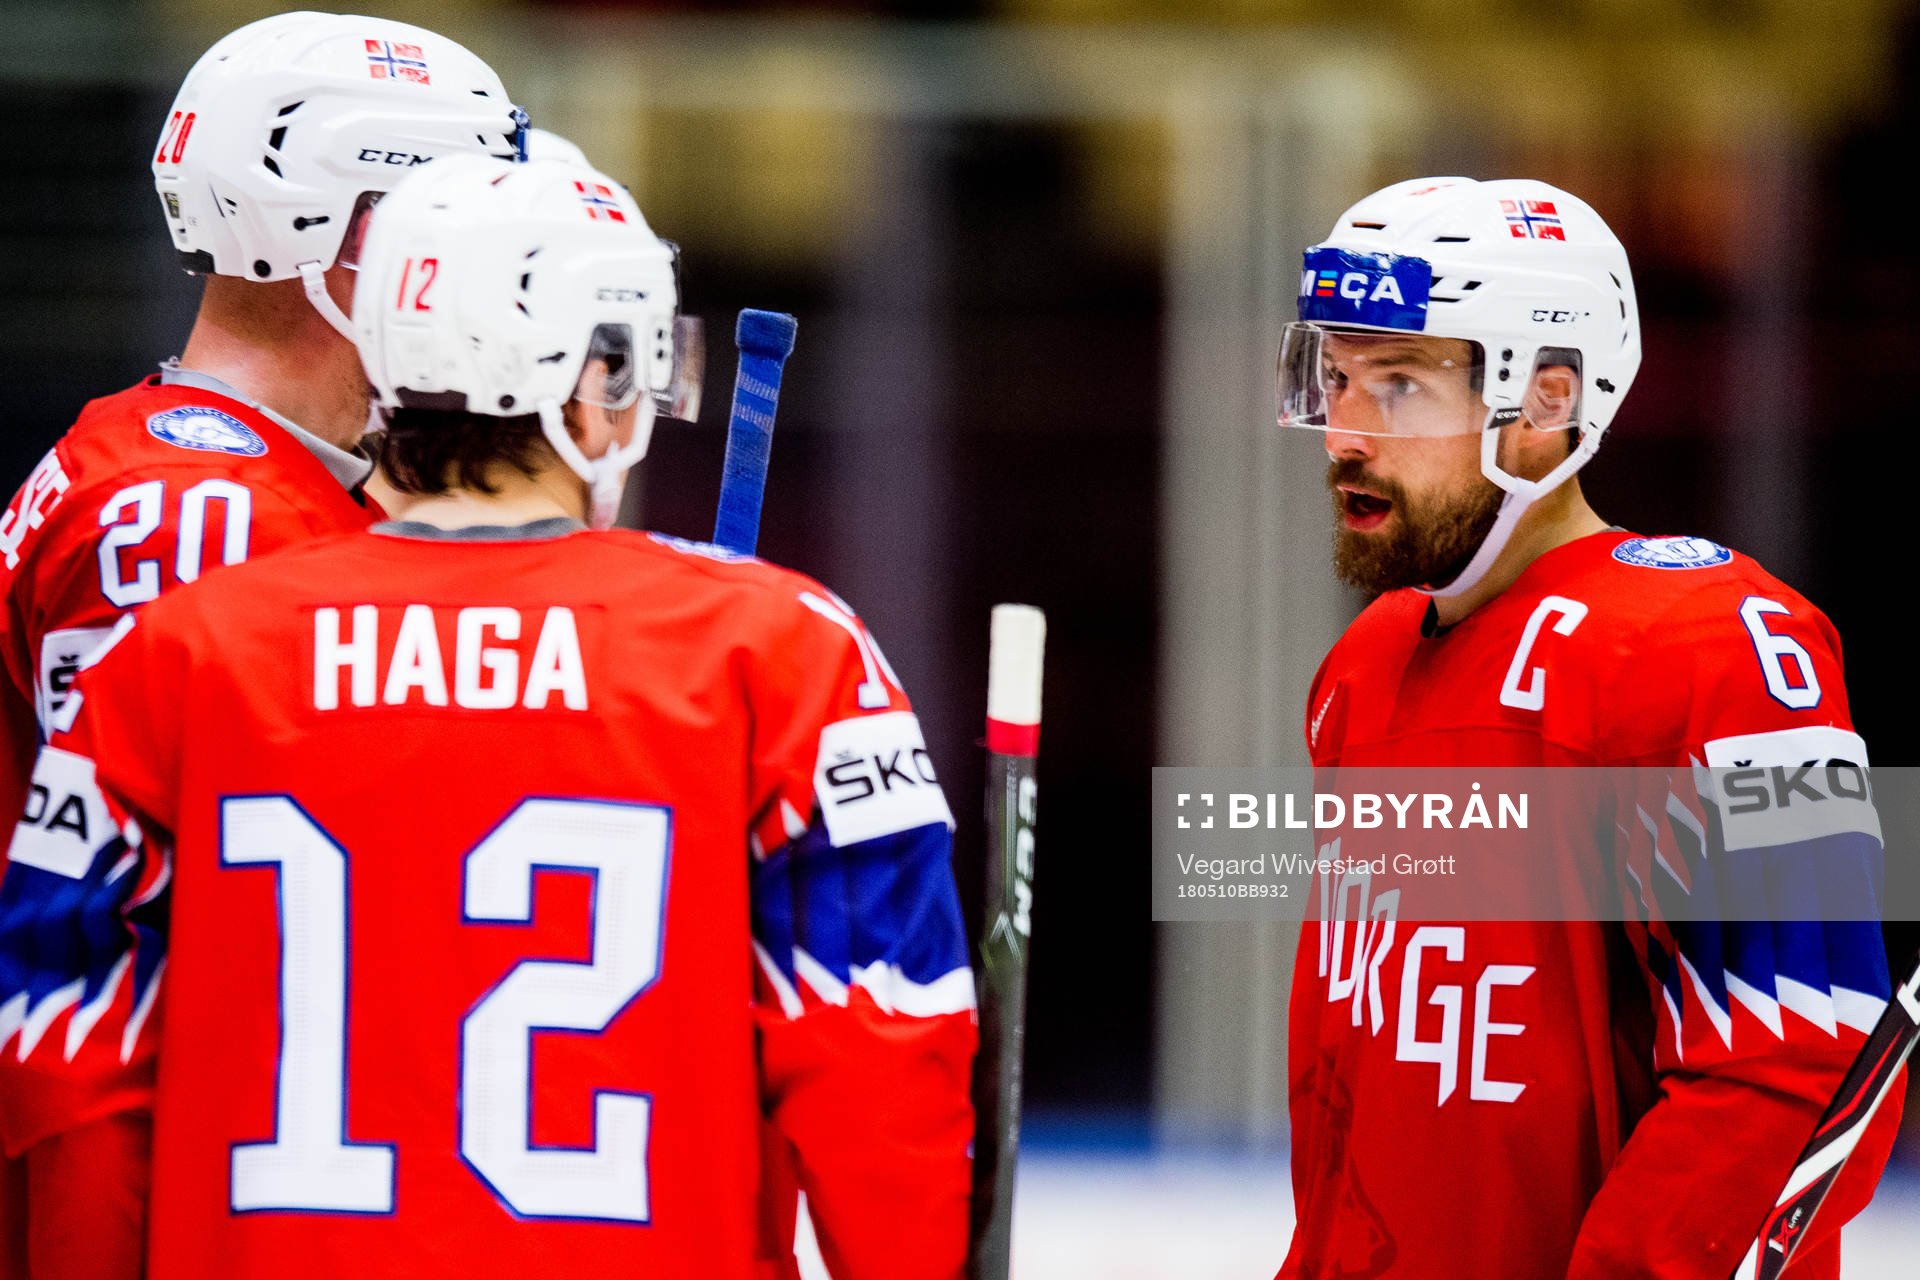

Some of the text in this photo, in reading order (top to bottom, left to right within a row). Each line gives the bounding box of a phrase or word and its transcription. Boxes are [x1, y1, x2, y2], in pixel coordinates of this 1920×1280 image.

[157, 111, 196, 163] 20
[357, 149, 433, 166] CCM
[397, 258, 439, 311] 12
[597, 288, 649, 301] CCM
[98, 478, 252, 608] 20
[313, 604, 588, 711] HAGA
[1500, 595, 1588, 711] C
[1738, 595, 1823, 711] 6
[218, 794, 673, 1223] 12
[1317, 836, 1537, 1108] NORGE
